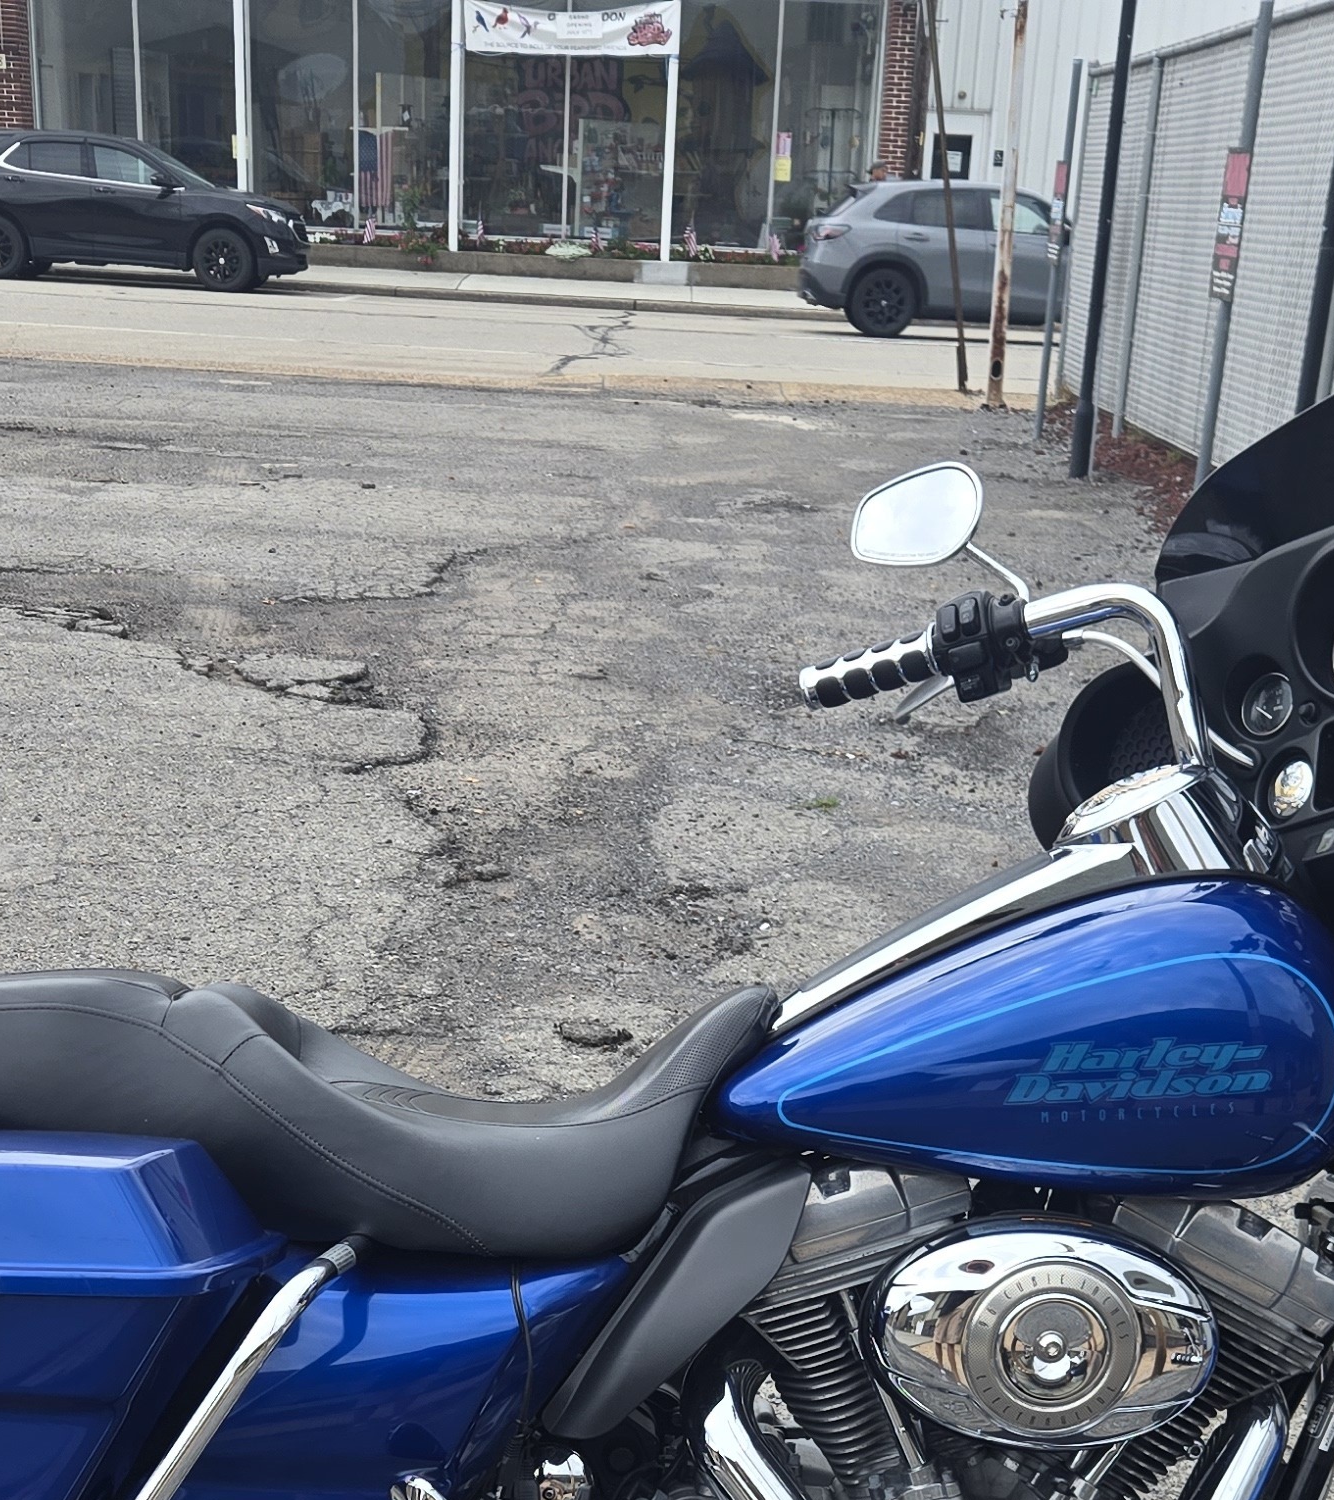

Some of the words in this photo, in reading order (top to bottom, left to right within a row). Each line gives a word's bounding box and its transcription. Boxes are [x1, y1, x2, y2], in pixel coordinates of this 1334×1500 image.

[523, 58, 618, 91] URBAN
[1040, 1036, 1268, 1074] Harley-
[1003, 1069, 1272, 1105] Davidson
[1040, 1101, 1235, 1124] MOTORCYCLES
[977, 1307, 997, 1329] 96
[1003, 1273, 1065, 1299] CUBIC
[1080, 1279, 1129, 1340] INCHES
